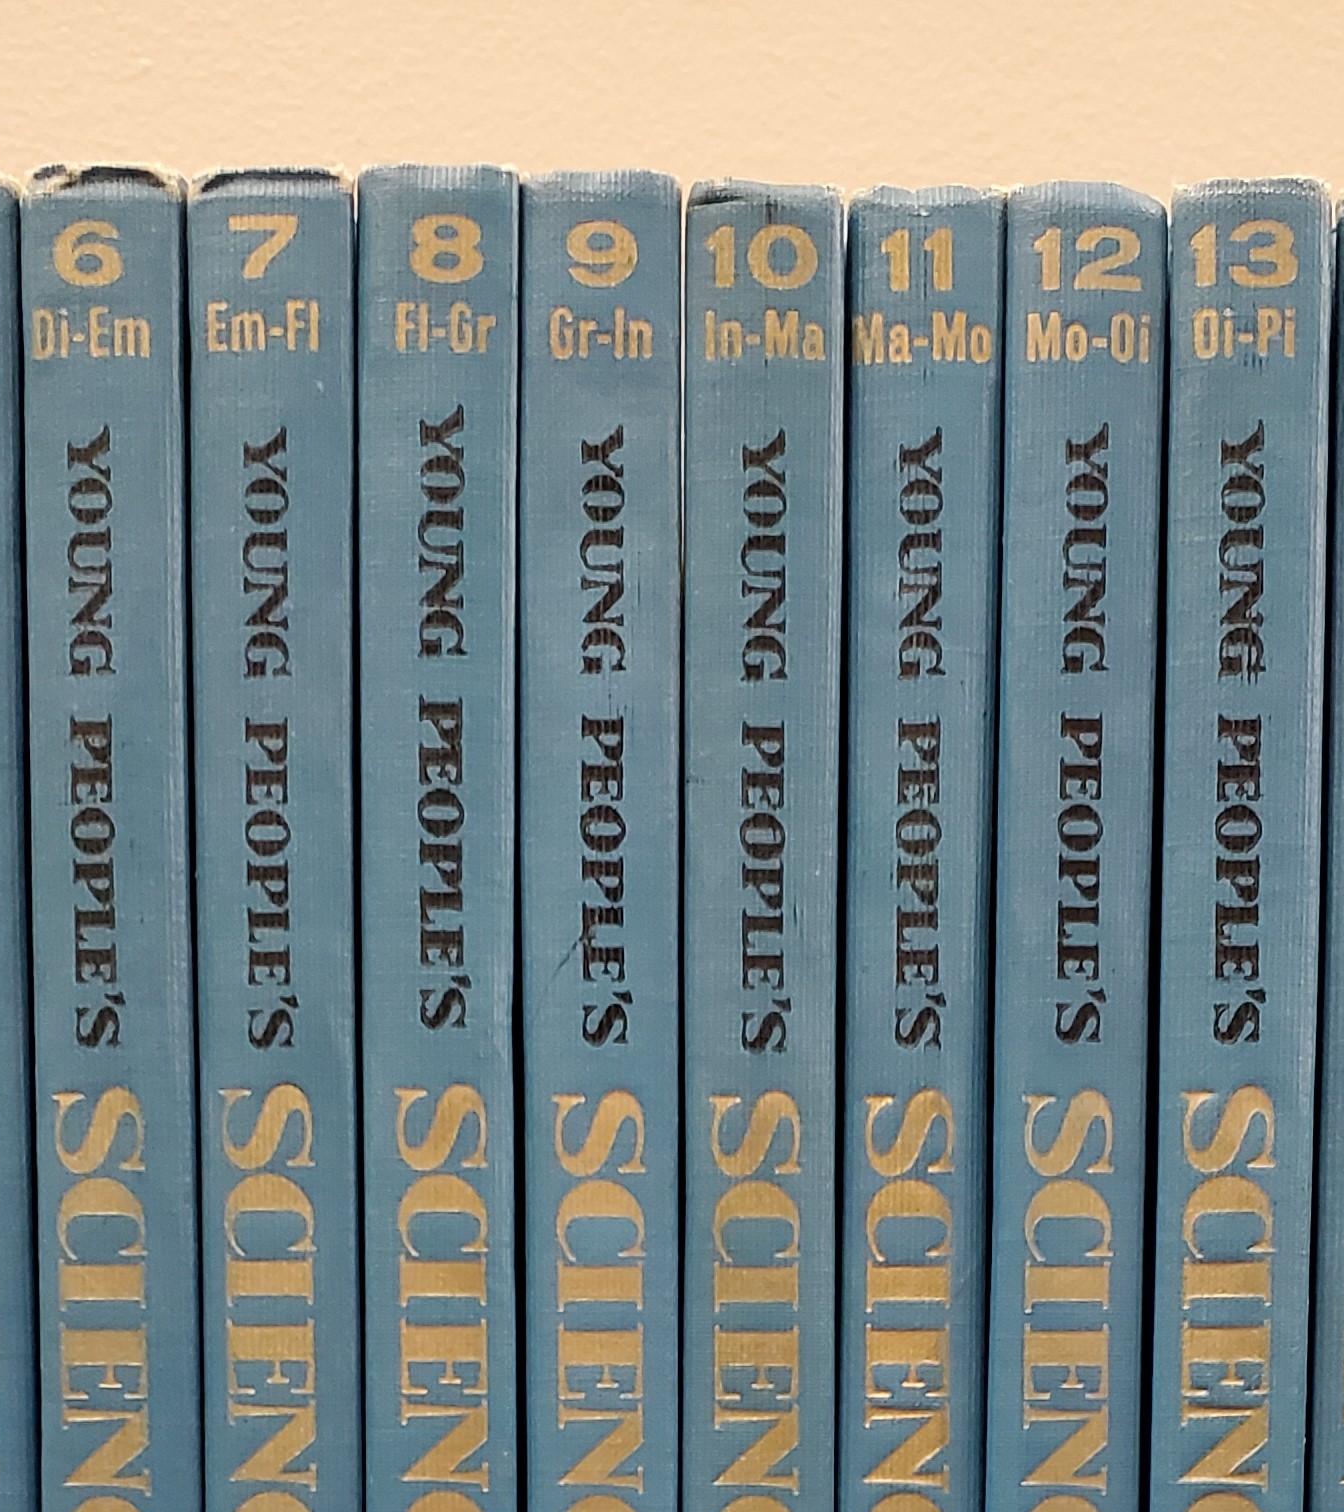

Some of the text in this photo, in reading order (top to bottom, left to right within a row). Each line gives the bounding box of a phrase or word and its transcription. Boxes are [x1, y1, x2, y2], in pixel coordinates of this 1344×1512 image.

[53, 220, 123, 286] 6
[228, 214, 298, 278] 7
[410, 214, 483, 283] 8
[566, 220, 638, 286] 9
[706, 224, 818, 289] 10
[880, 227, 953, 292] 11
[1034, 226, 1141, 291] 12
[1190, 220, 1298, 288] 13
[32, 305, 151, 360] Di-Em
[207, 299, 320, 352] Em-Fl
[395, 301, 496, 353] Fl-Gr
[549, 306, 653, 360] Gr-In
[704, 308, 825, 361] In-Ma
[853, 310, 992, 364] Ma-Mo
[1026, 311, 1149, 362] Mo-Oi
[1192, 306, 1296, 359] Oi-Pi
[242, 426, 292, 678] YOUNG
[417, 403, 468, 658] YOUNG
[740, 428, 788, 682] YOUNG
[1060, 422, 1109, 674] YOUNG
[244, 716, 300, 1049] PEOPLE'S
[417, 694, 472, 1030] PEOPLE'S
[739, 720, 792, 1054] PEOPLE'S
[1055, 711, 1107, 1044] PEOPLE'S
